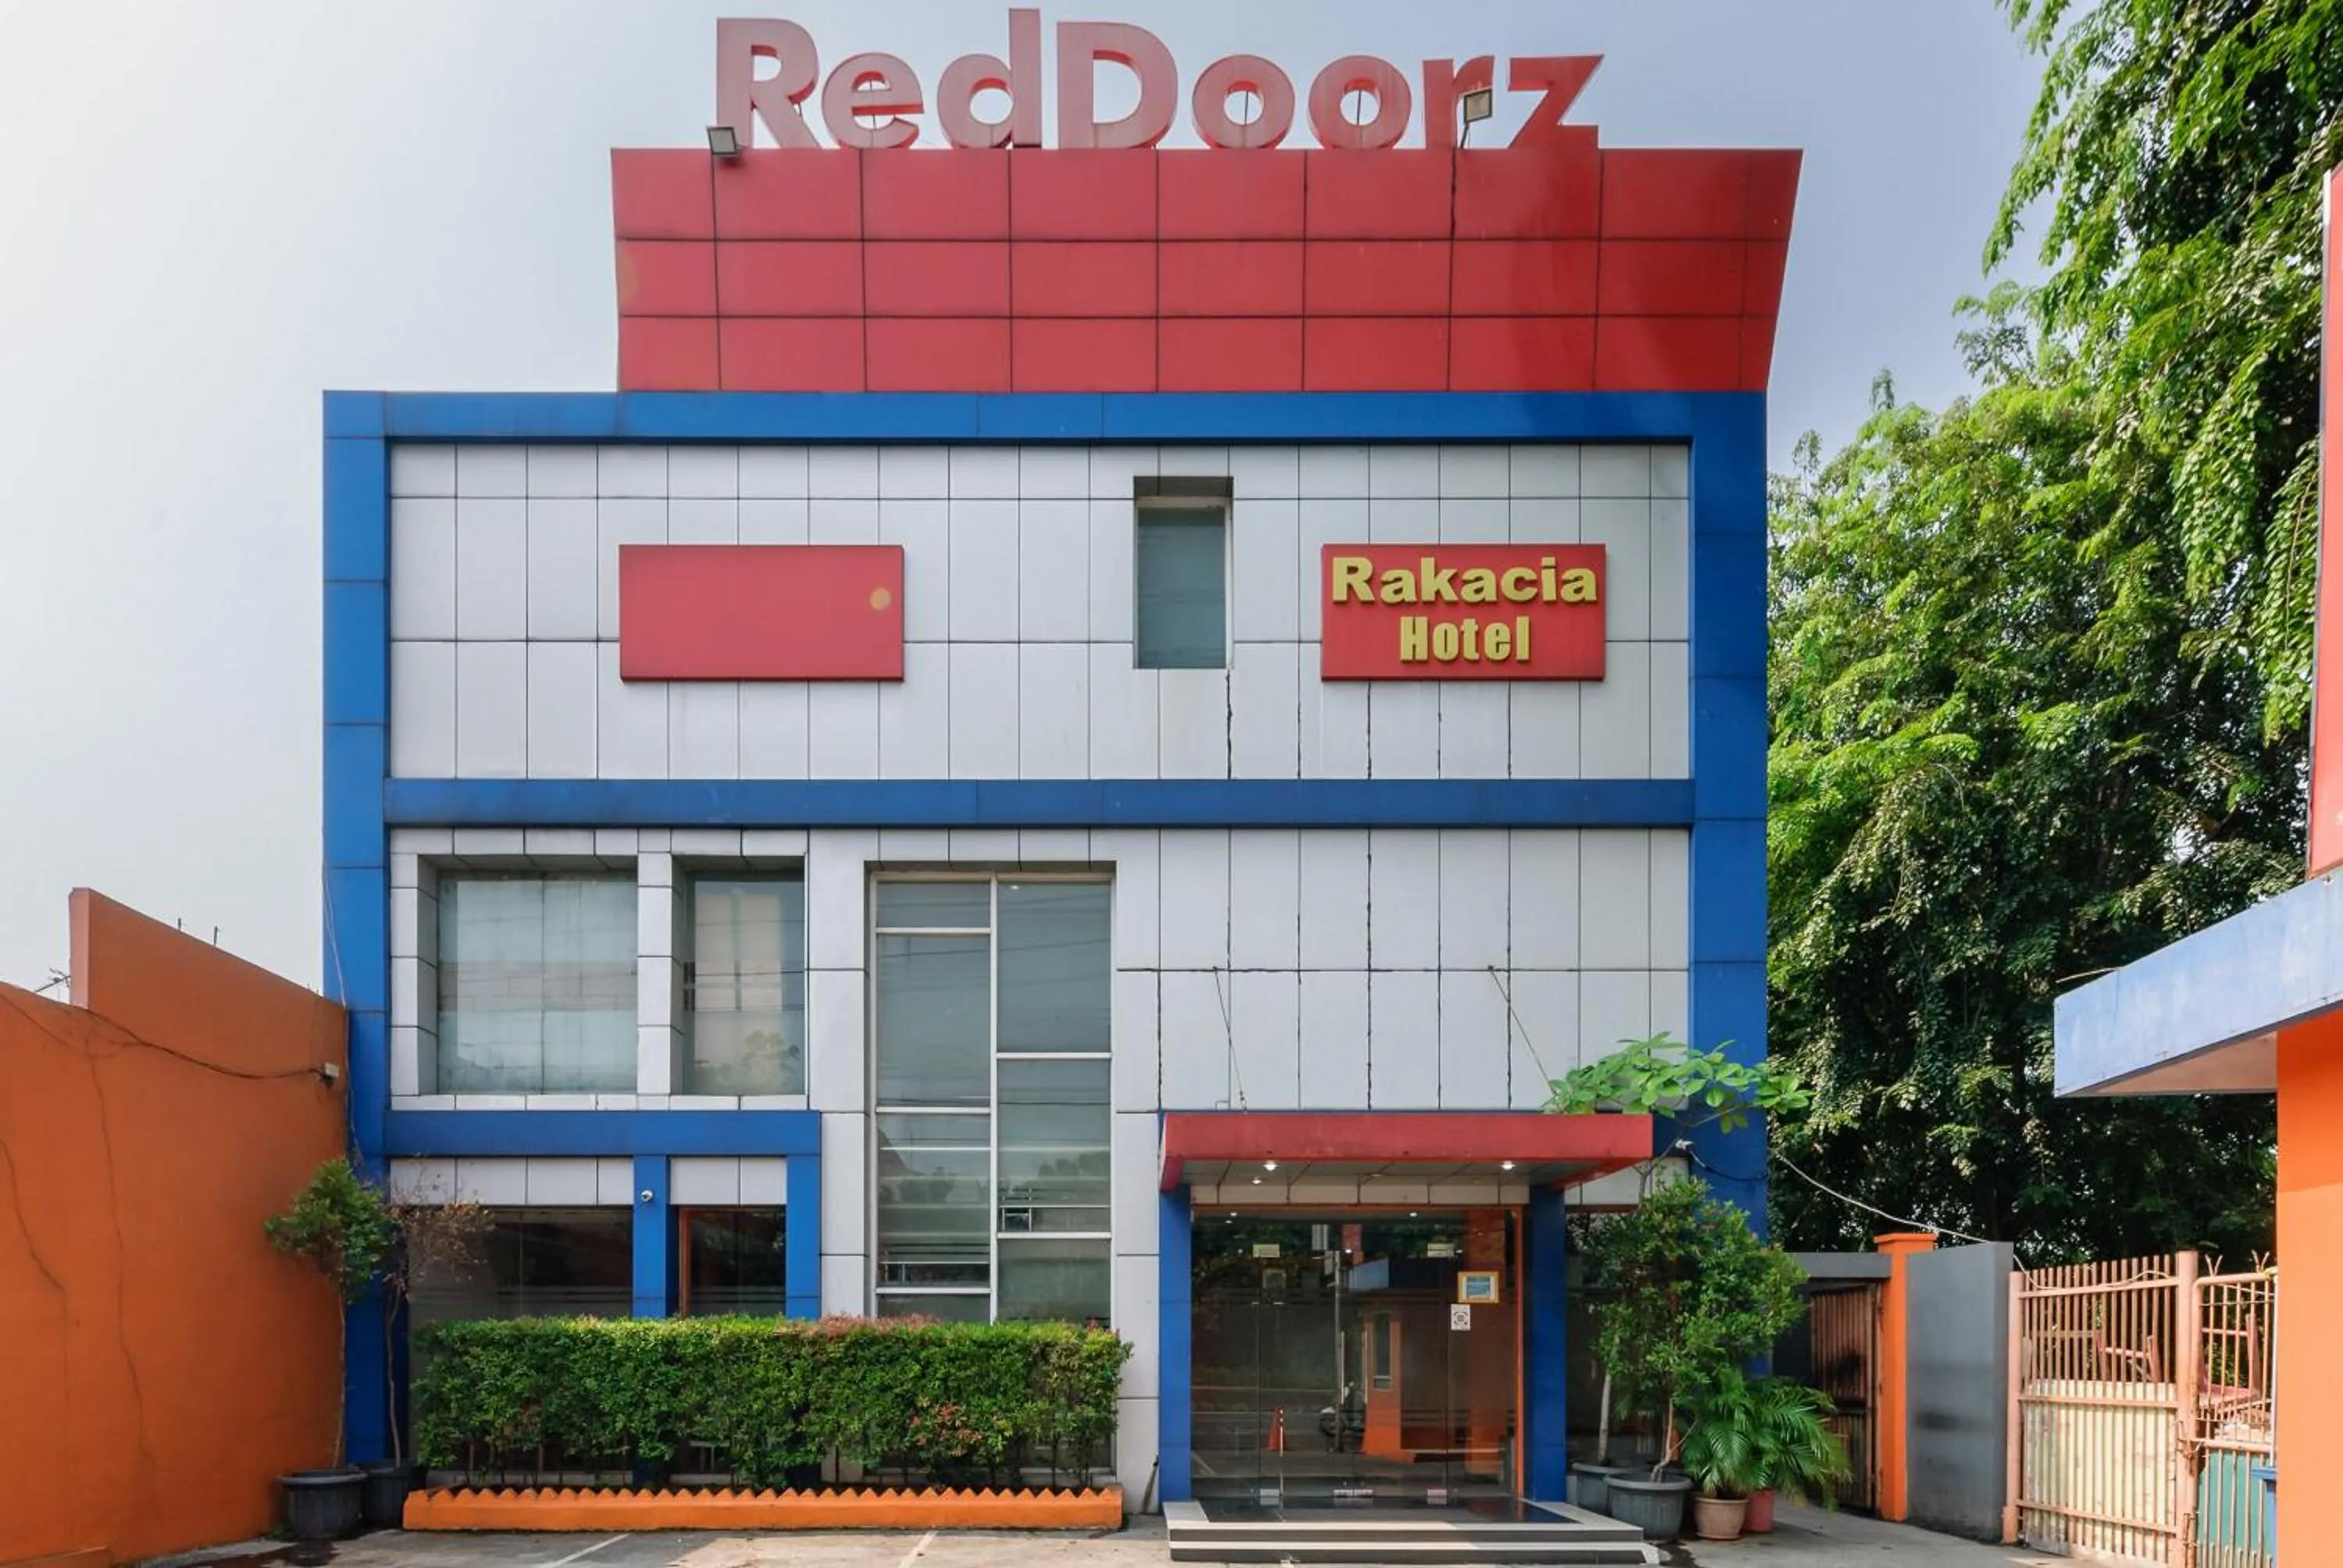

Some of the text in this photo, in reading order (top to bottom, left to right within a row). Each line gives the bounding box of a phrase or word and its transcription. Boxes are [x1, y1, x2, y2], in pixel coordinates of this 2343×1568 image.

[716, 8, 1604, 150] RedDoorz
[1332, 555, 1598, 604] Rakacia
[1400, 615, 1531, 663] Hotel
